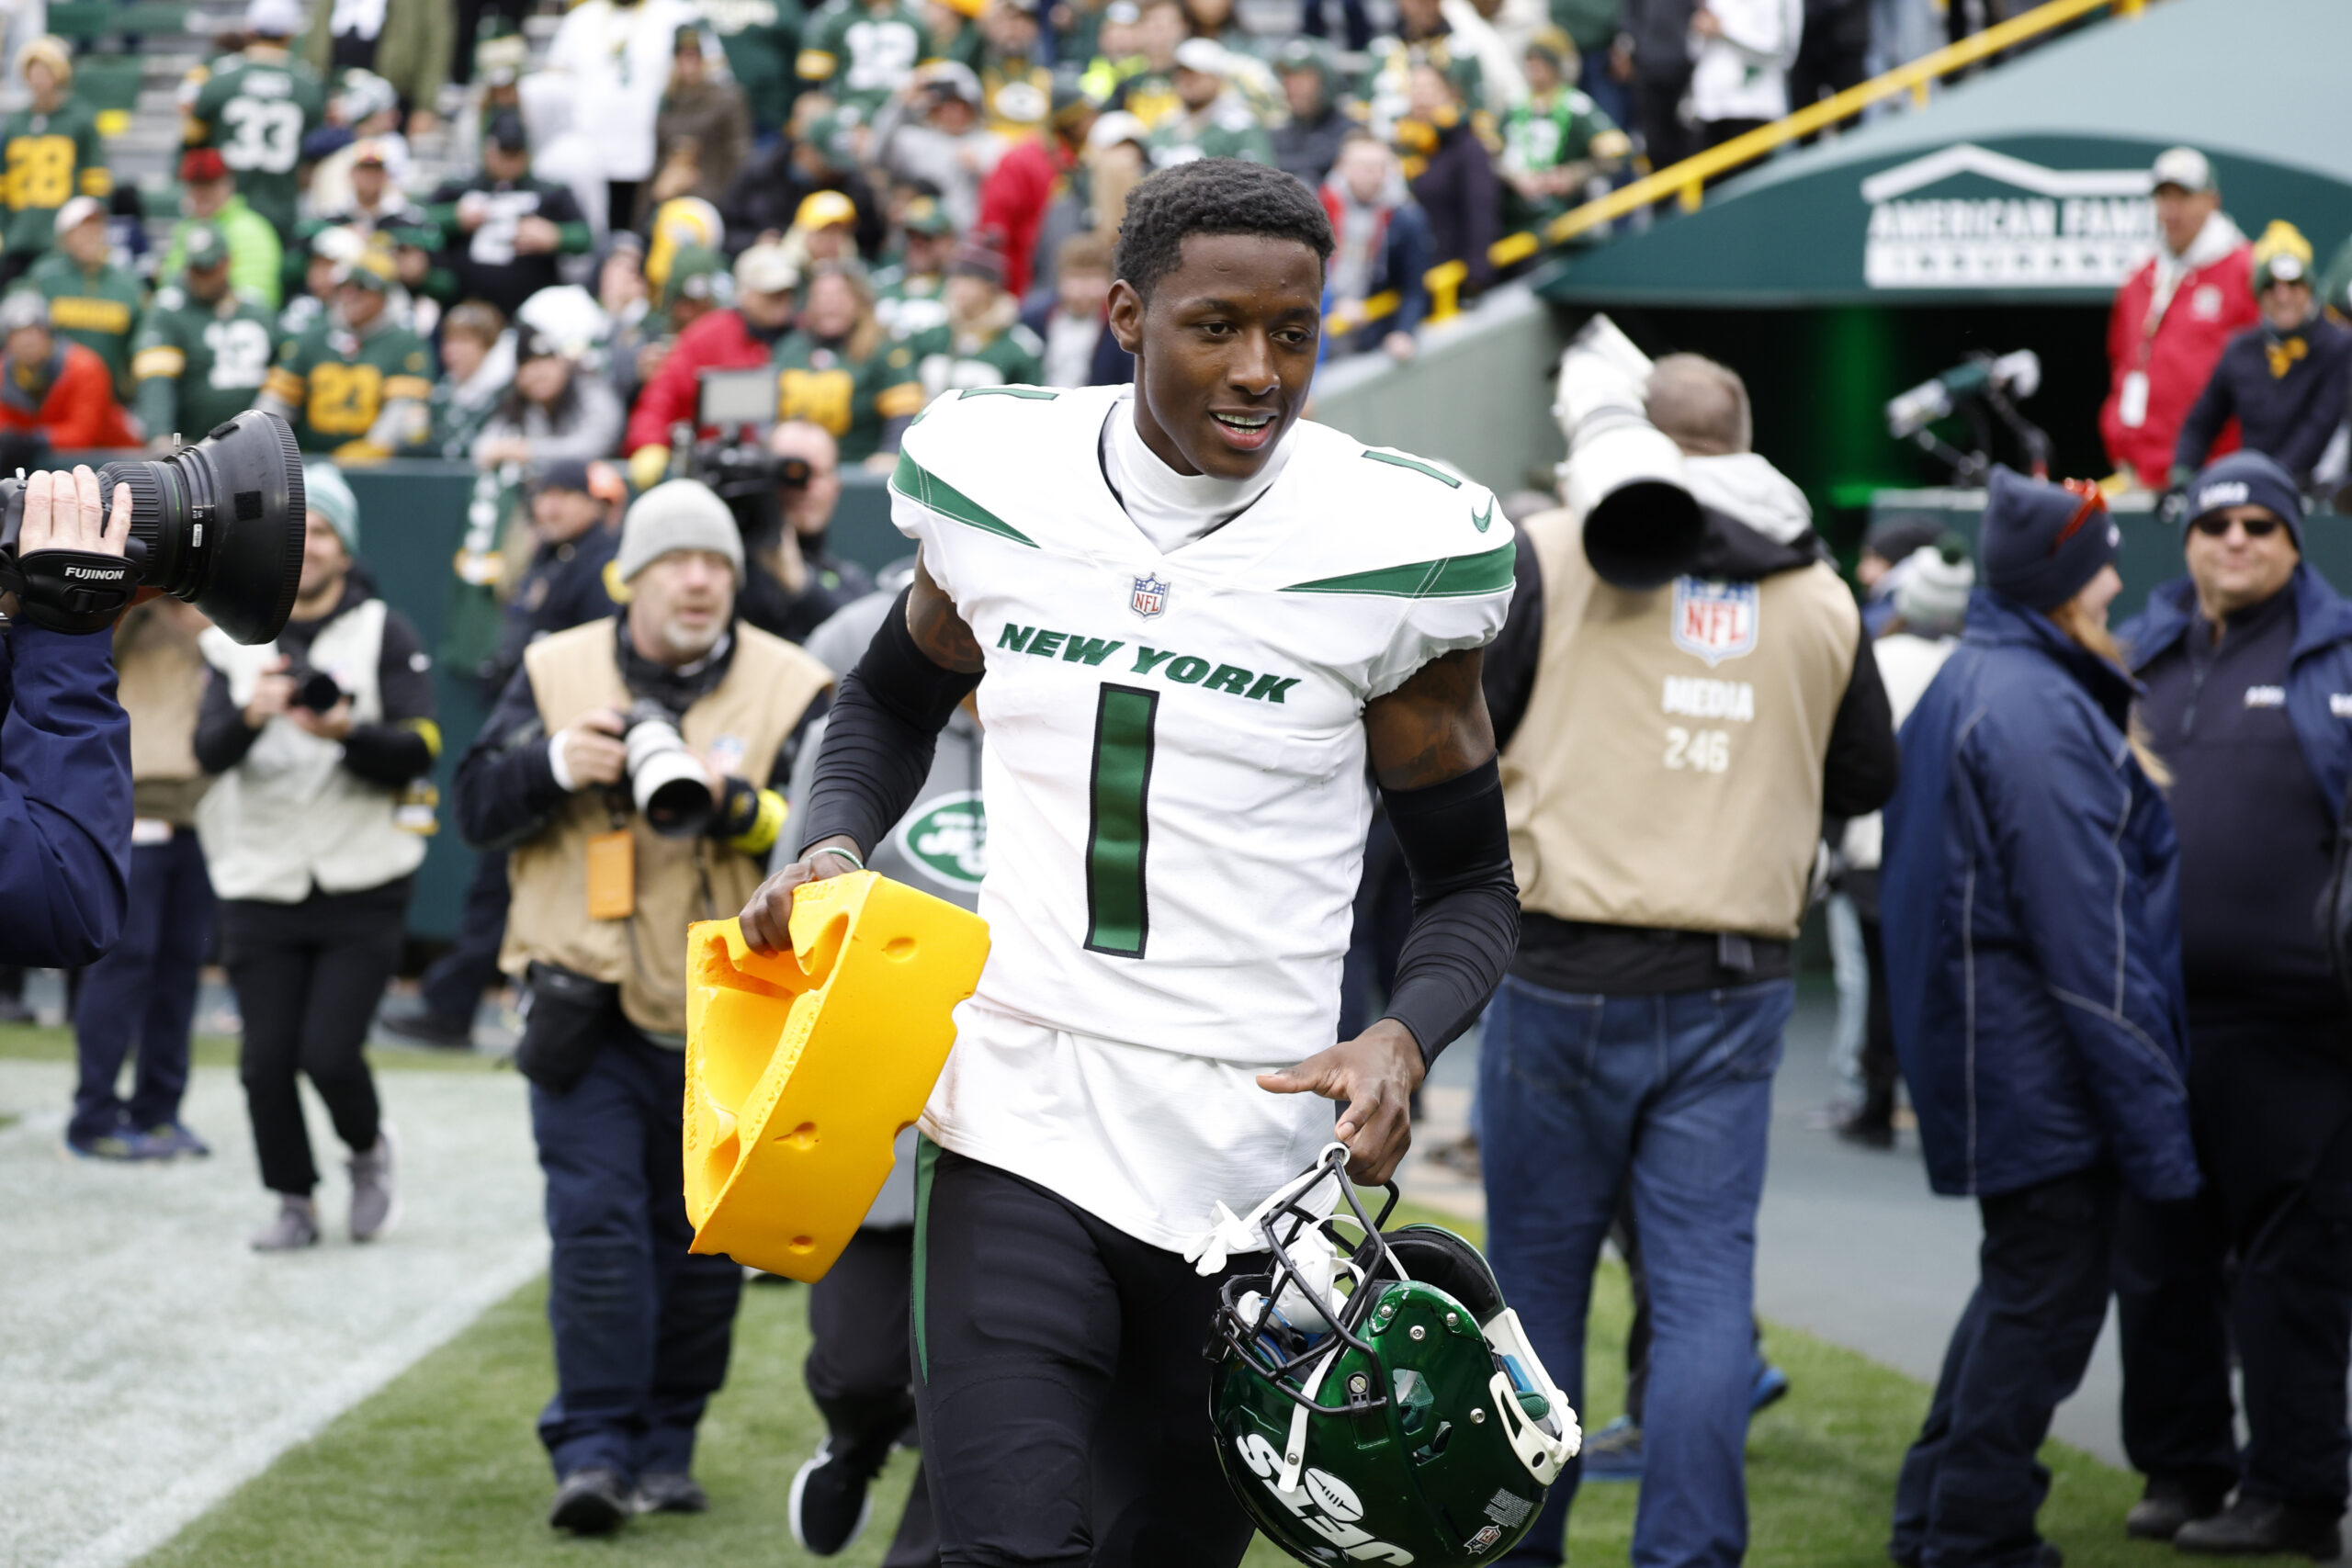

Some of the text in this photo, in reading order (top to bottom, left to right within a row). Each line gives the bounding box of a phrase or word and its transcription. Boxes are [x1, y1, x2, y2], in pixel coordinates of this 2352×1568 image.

[221, 96, 304, 174] 33
[204, 319, 270, 389] 12
[64, 567, 125, 581] FUJINON
[1135, 592, 1159, 613] NFL
[1685, 599, 1747, 645] NFL
[997, 623, 1302, 704] NEW YORK
[1662, 673, 1755, 722] MEDIA
[1663, 726, 1730, 773] 246
[1083, 682, 1160, 959] 1
[1478, 1529, 1498, 1544] NFL
